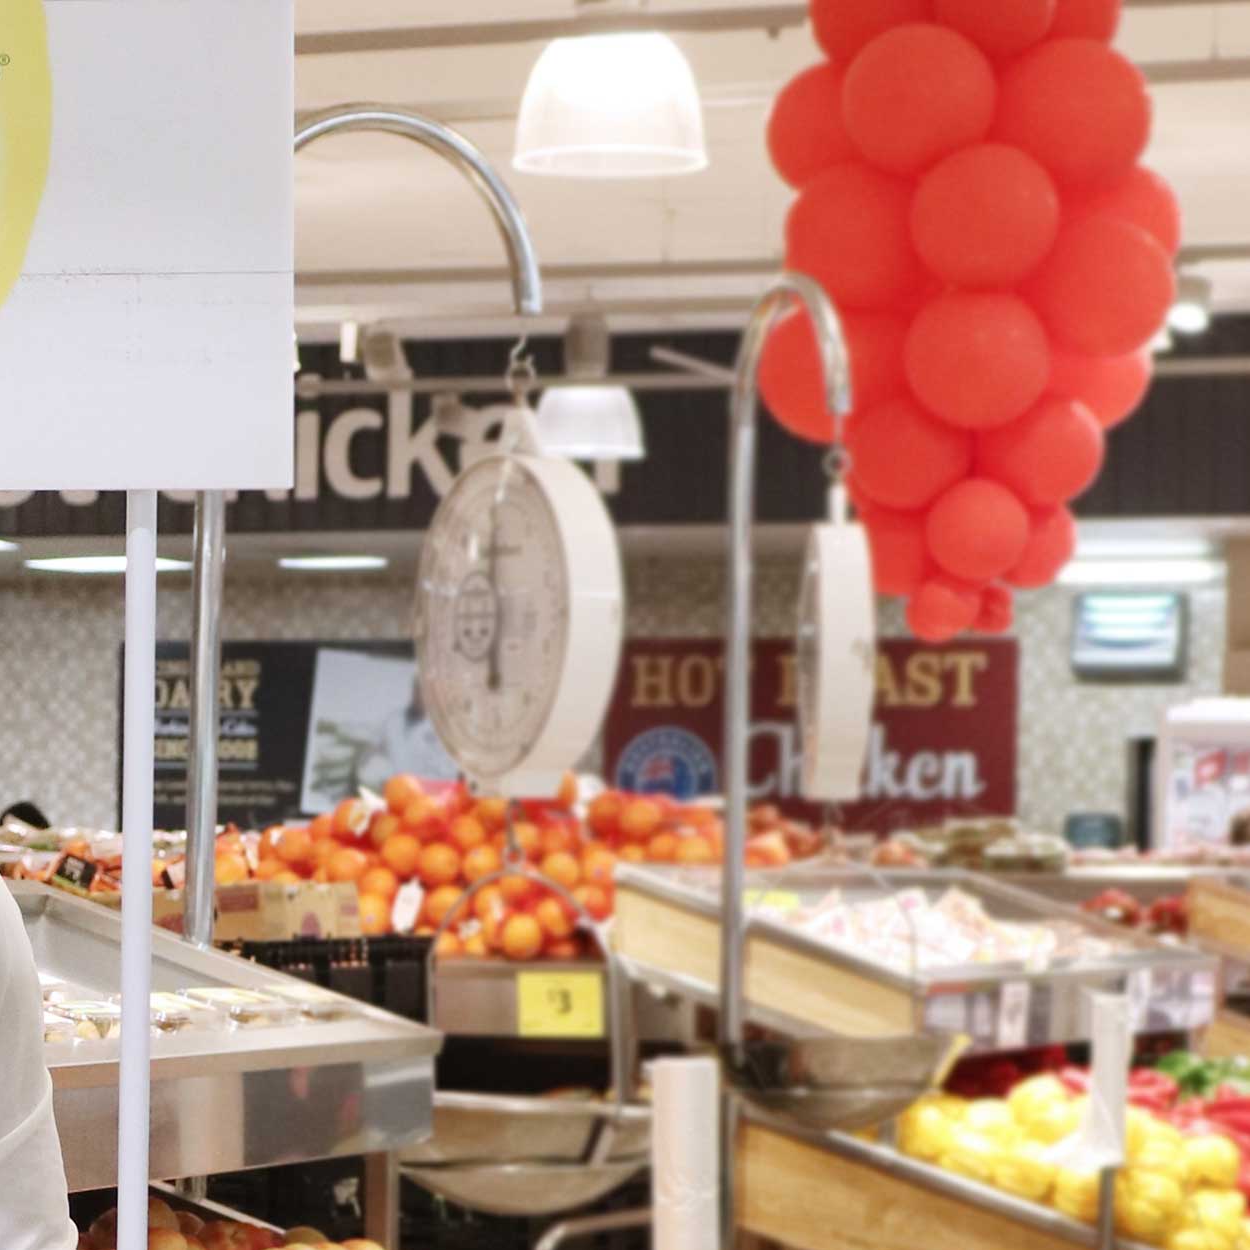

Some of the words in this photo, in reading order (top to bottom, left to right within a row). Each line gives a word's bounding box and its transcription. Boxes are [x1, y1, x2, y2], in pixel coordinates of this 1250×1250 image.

[155, 678, 260, 709] DARY
[630, 656, 756, 708] HO
[742, 720, 988, 801] Chken
